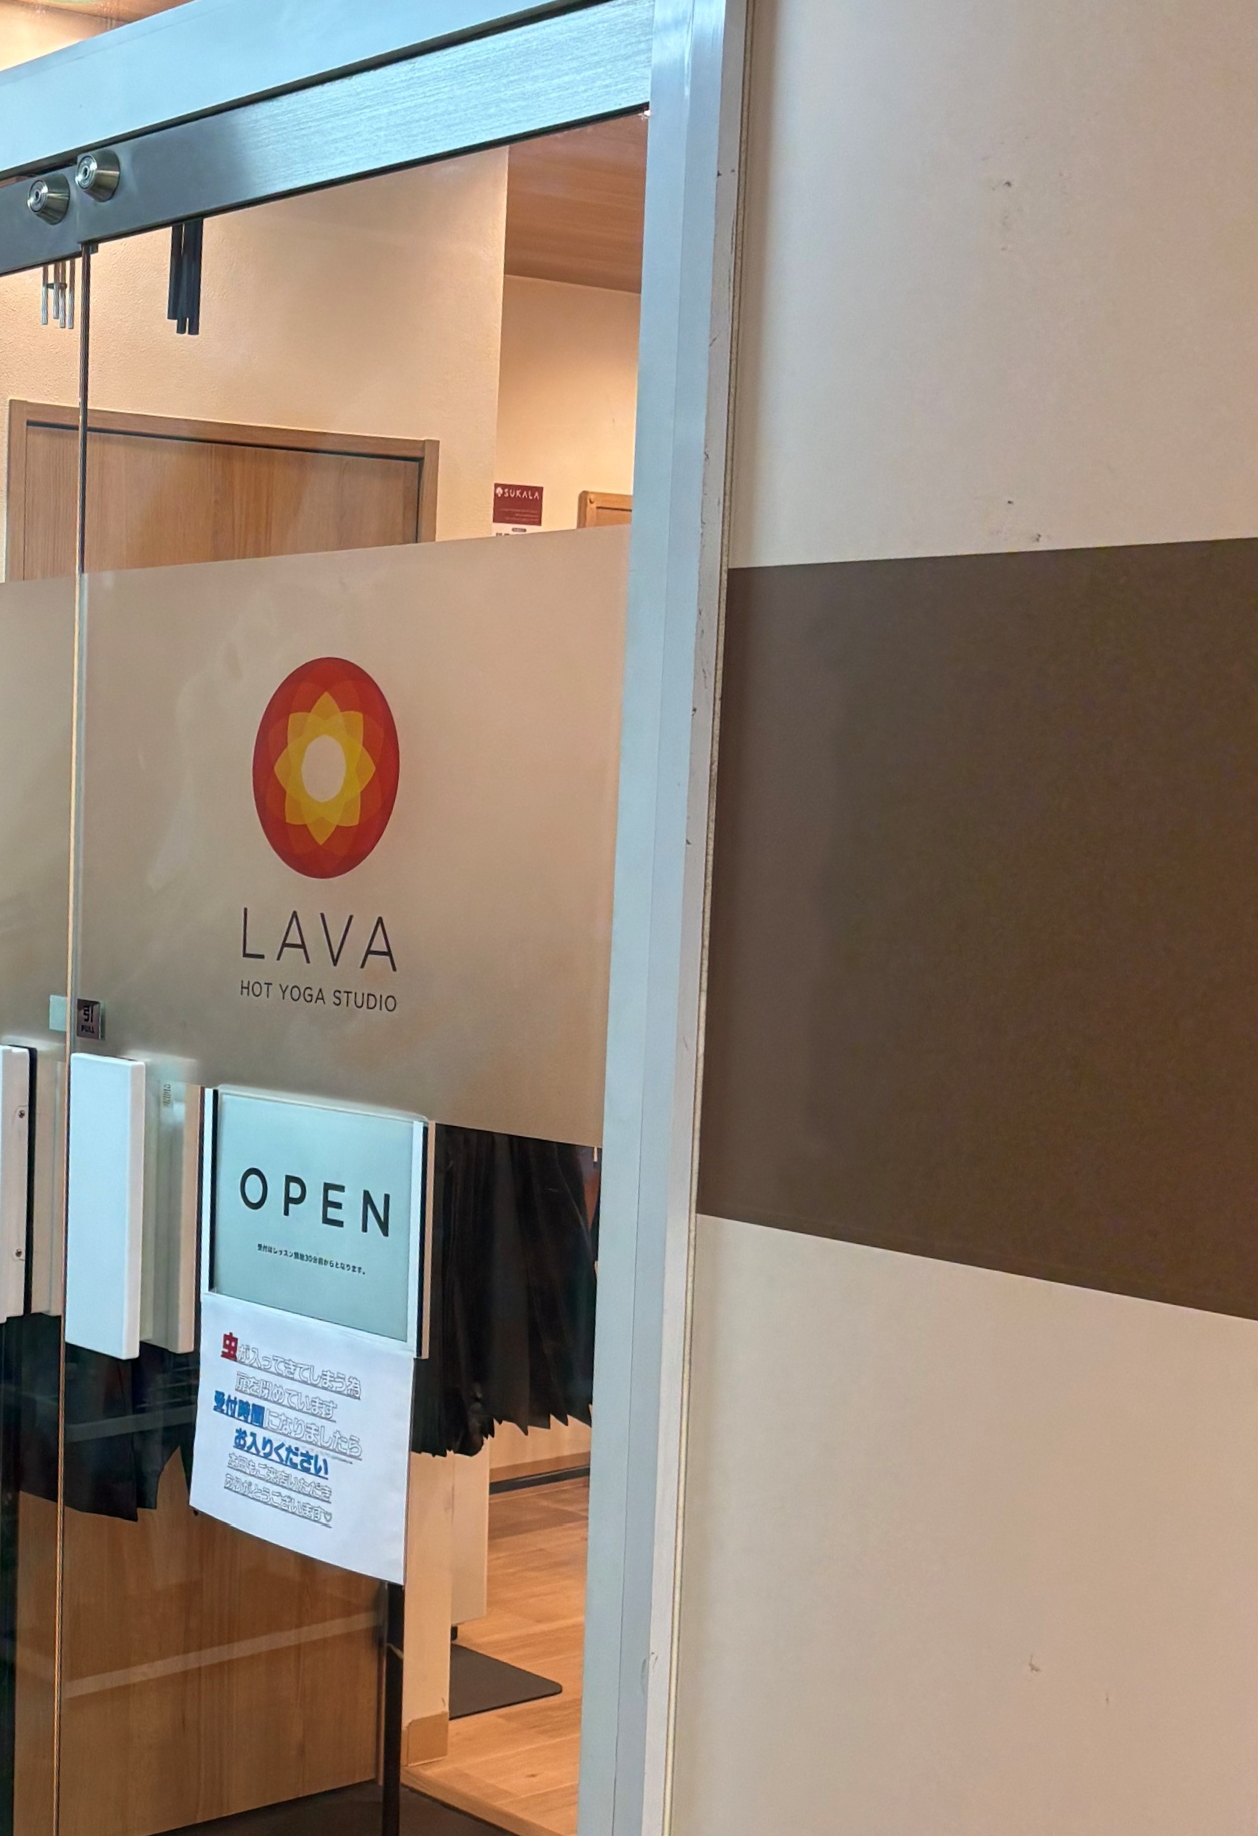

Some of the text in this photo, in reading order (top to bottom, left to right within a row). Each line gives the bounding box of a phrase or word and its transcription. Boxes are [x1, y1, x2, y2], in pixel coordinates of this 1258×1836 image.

[503, 488, 540, 500] SUKALA
[242, 907, 397, 972] LAVA
[82, 1005, 94, 1023] 引
[240, 980, 397, 1012] HOT YOGA STUDIO
[80, 1025, 95, 1034] PULL
[240, 1167, 391, 1238] OPEN
[220, 1331, 361, 1399] 虫が入ってきてしまう為
[235, 1370, 338, 1420] 扉を閉めています
[213, 1390, 362, 1458] 受付時間になりましたら
[233, 1427, 329, 1475] お入りください
